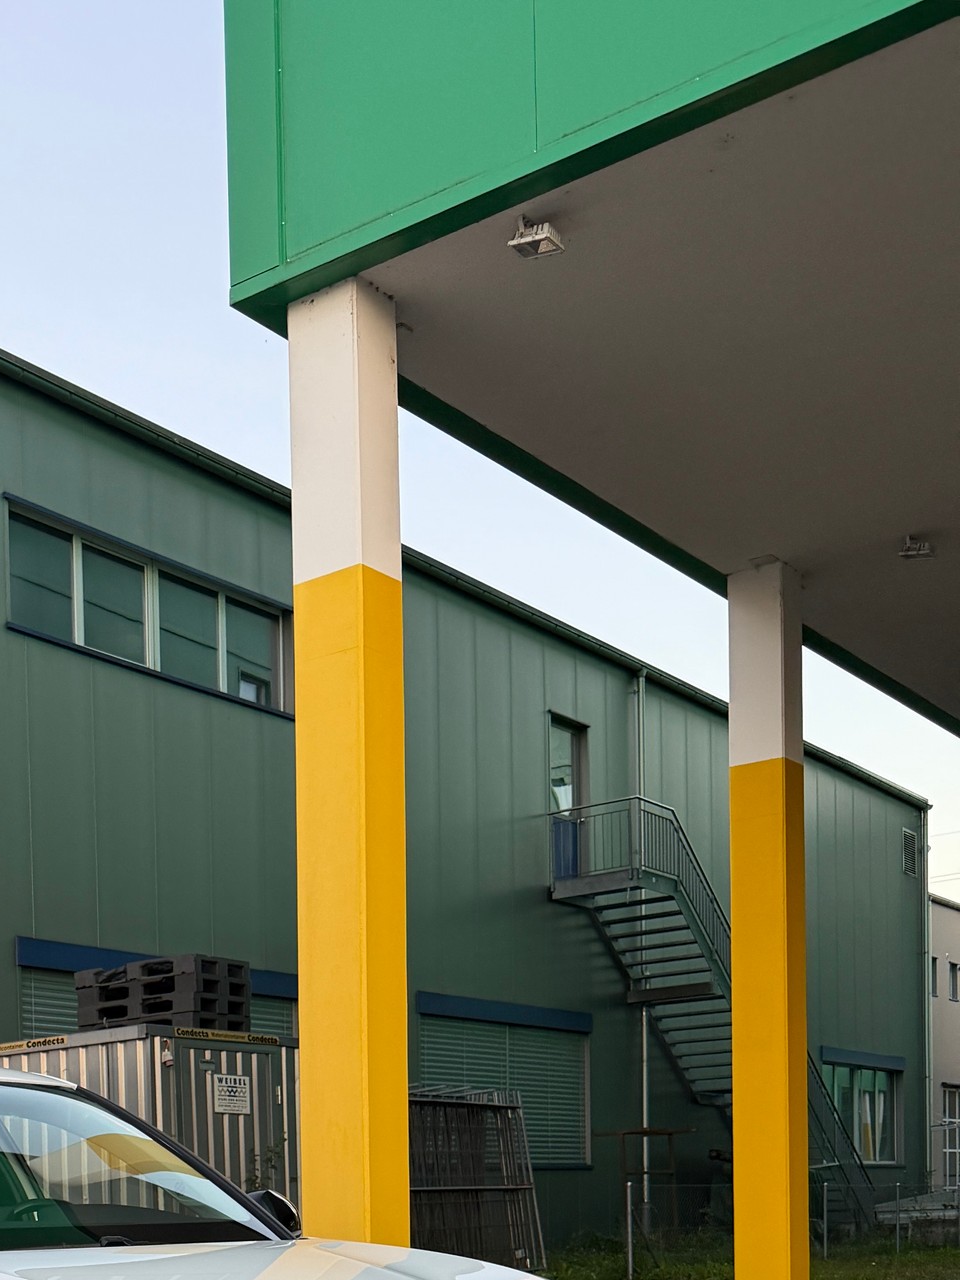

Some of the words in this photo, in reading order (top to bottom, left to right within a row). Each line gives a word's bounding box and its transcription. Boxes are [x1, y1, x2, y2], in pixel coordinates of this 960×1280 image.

[176, 1028, 209, 1038] Condecta
[247, 1034, 278, 1045] Condecta
[26, 1037, 65, 1049] Condecta
[217, 1076, 246, 1086] WEIBEL
